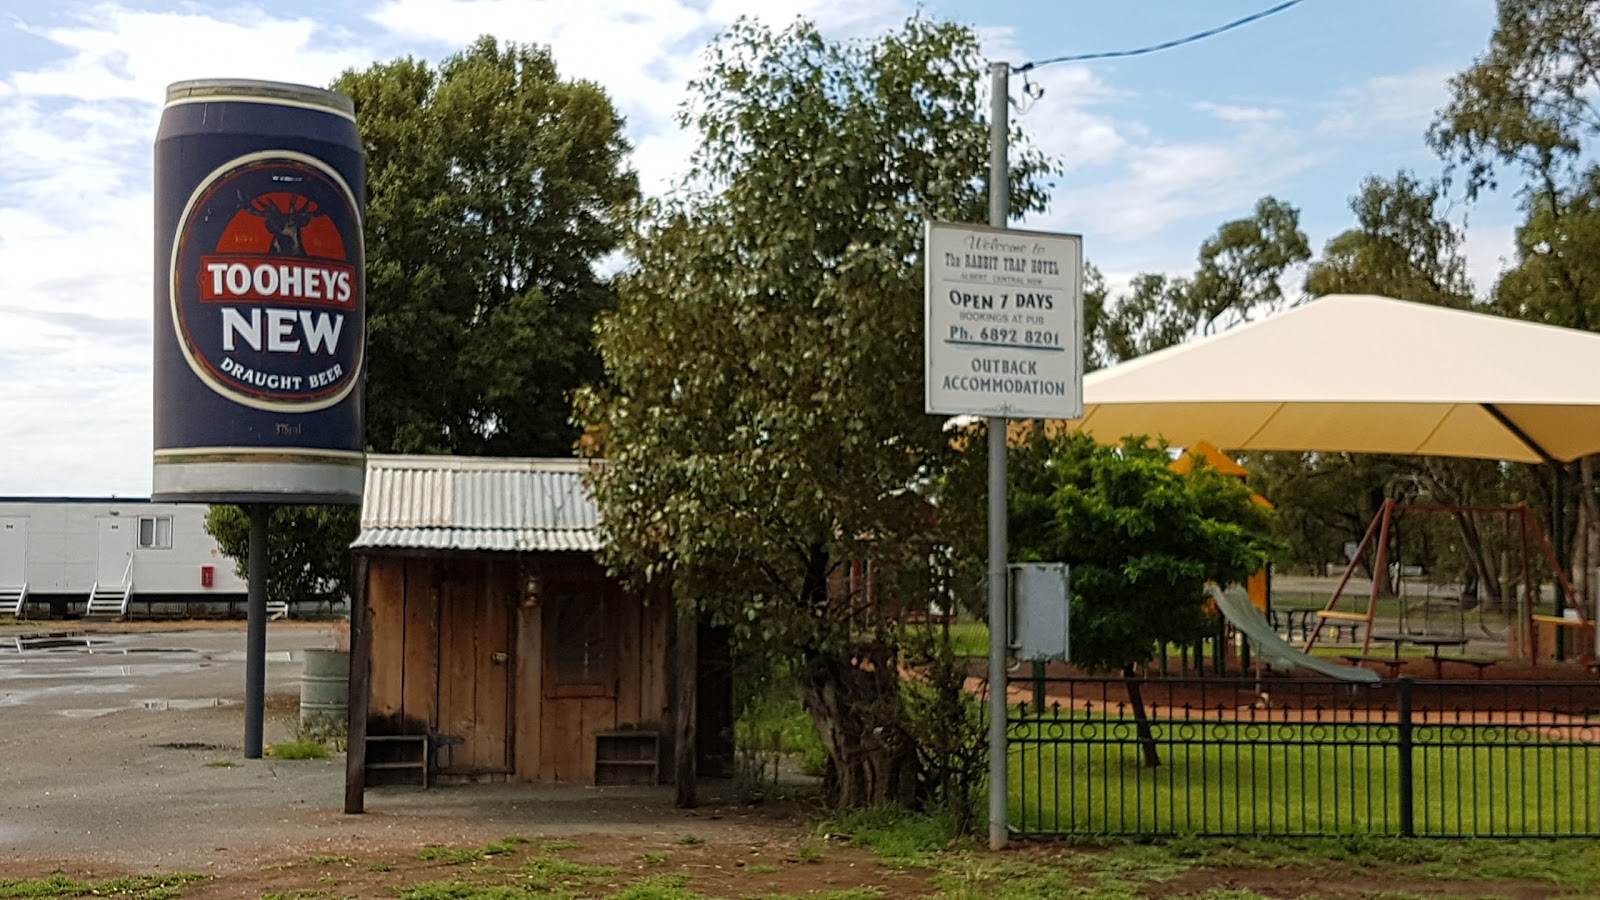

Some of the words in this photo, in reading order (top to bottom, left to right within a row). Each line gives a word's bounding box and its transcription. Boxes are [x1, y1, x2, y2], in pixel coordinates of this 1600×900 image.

[966, 235, 1026, 254] Welcome
[1032, 241, 1046, 256] to
[945, 252, 961, 267] The
[965, 253, 999, 271] RABBIT
[1004, 256, 1027, 274] TRAP
[1031, 259, 1059, 275] HOTEL
[208, 263, 351, 302] TOOHEYS
[949, 289, 993, 310] OPEN
[1000, 293, 1009, 310] 7
[1016, 293, 1054, 311] DAYS
[959, 311, 1008, 323] BOOKINGS
[1011, 314, 1023, 324] AT
[1026, 315, 1045, 326] PUB
[221, 308, 344, 355] NEW
[950, 325, 973, 341] Ph.
[980, 327, 1017, 343] 6892
[1025, 330, 1060, 346] 8201
[220, 357, 302, 390] DRAUGHT
[309, 363, 343, 389] BEER
[971, 357, 1038, 376] OUTBACK
[942, 375, 1065, 396] ACCOMMODATION
